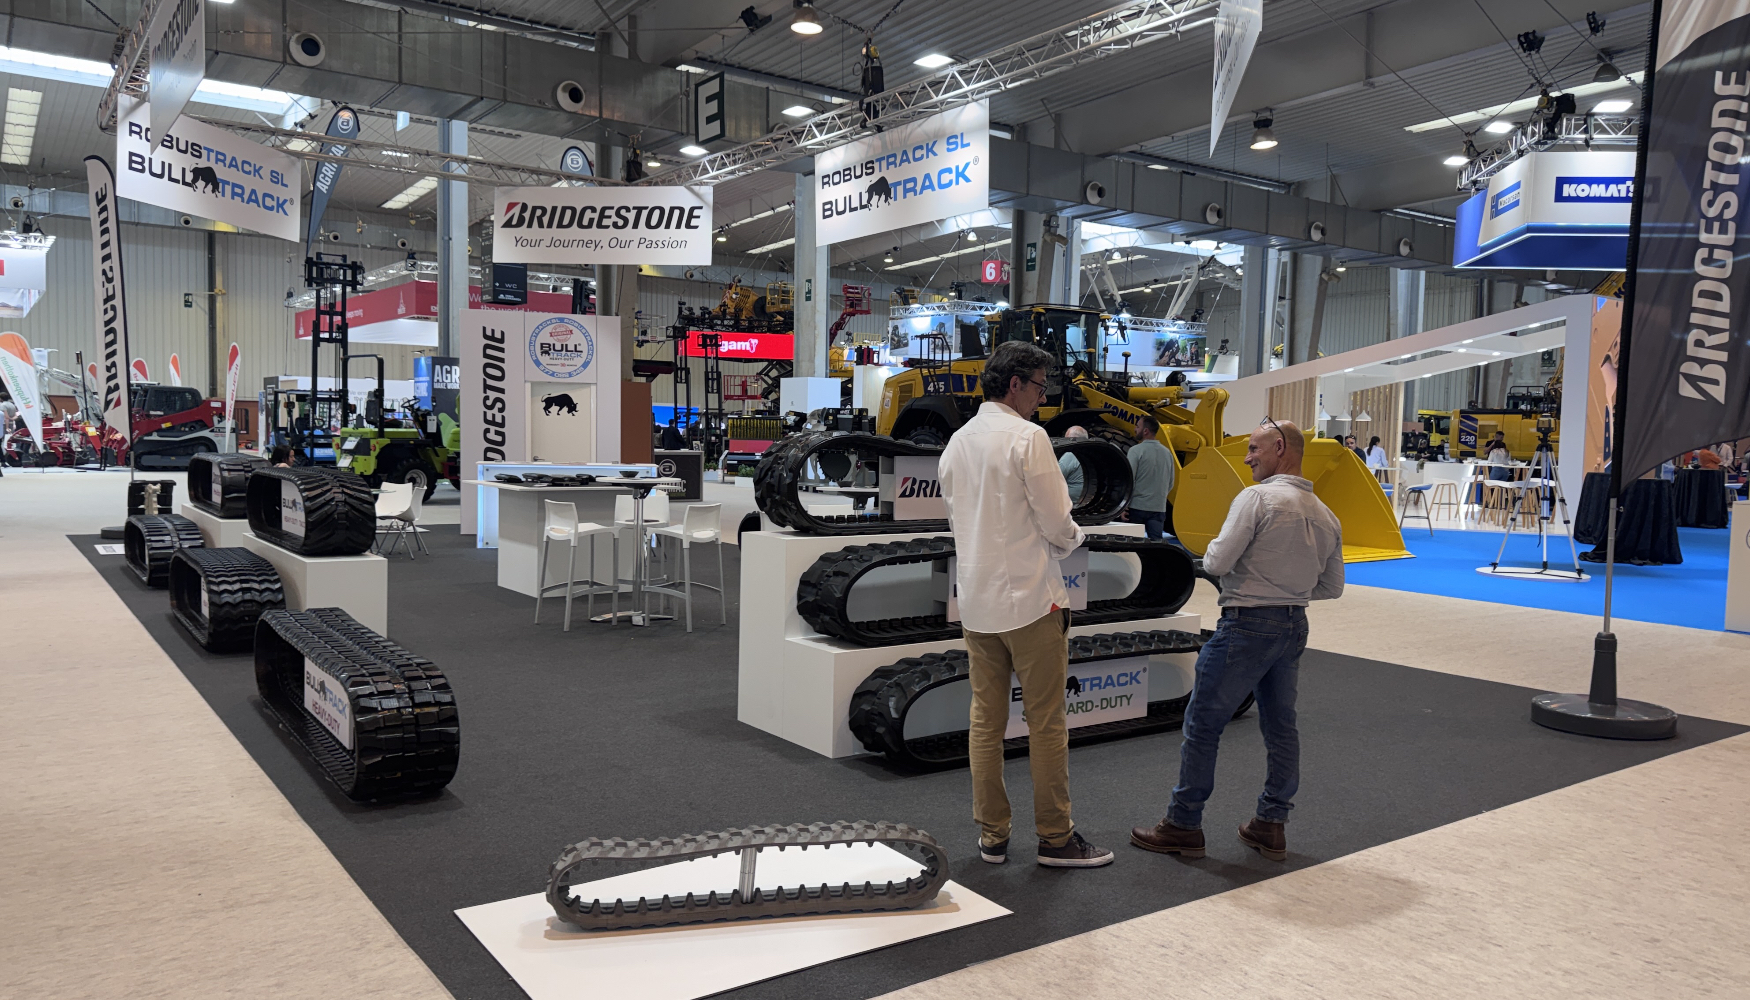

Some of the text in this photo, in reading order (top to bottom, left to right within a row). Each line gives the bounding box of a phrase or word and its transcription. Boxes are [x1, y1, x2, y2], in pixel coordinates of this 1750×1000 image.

[698, 77, 720, 142] E
[128, 151, 193, 187] BULL
[821, 132, 971, 189] ROBUSTRACK SL
[270, 169, 288, 188] SL
[501, 201, 703, 230] BRIDGESTONE
[822, 190, 868, 220] BULL
[514, 235, 688, 251] Your Journey, Our Passion
[1678, 70, 1750, 404] BRIDGESTONE
[986, 262, 996, 280] 6
